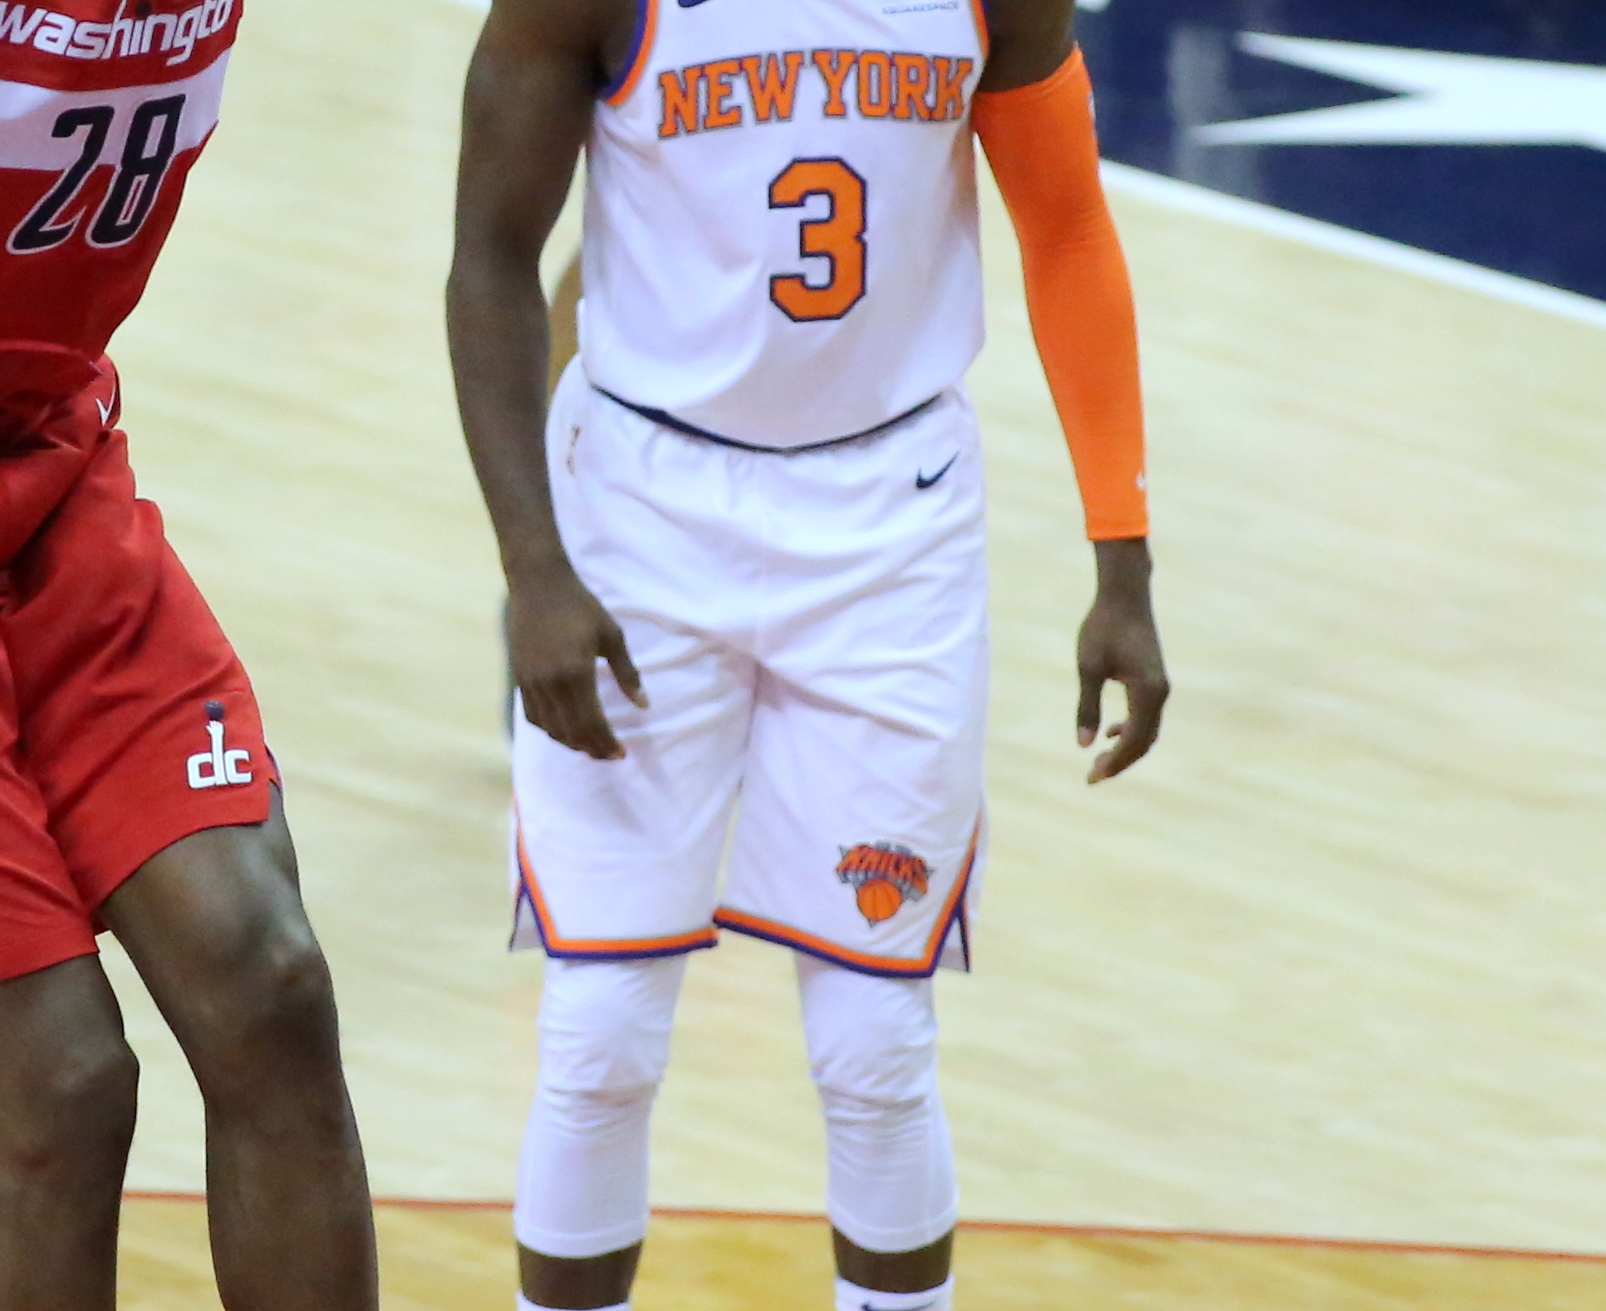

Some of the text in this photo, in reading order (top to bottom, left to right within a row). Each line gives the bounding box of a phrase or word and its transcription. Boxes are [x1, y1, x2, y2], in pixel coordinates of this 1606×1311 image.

[6, 92, 187, 255] 28
[657, 48, 975, 141] NEW YORK
[768, 155, 868, 324] 3
